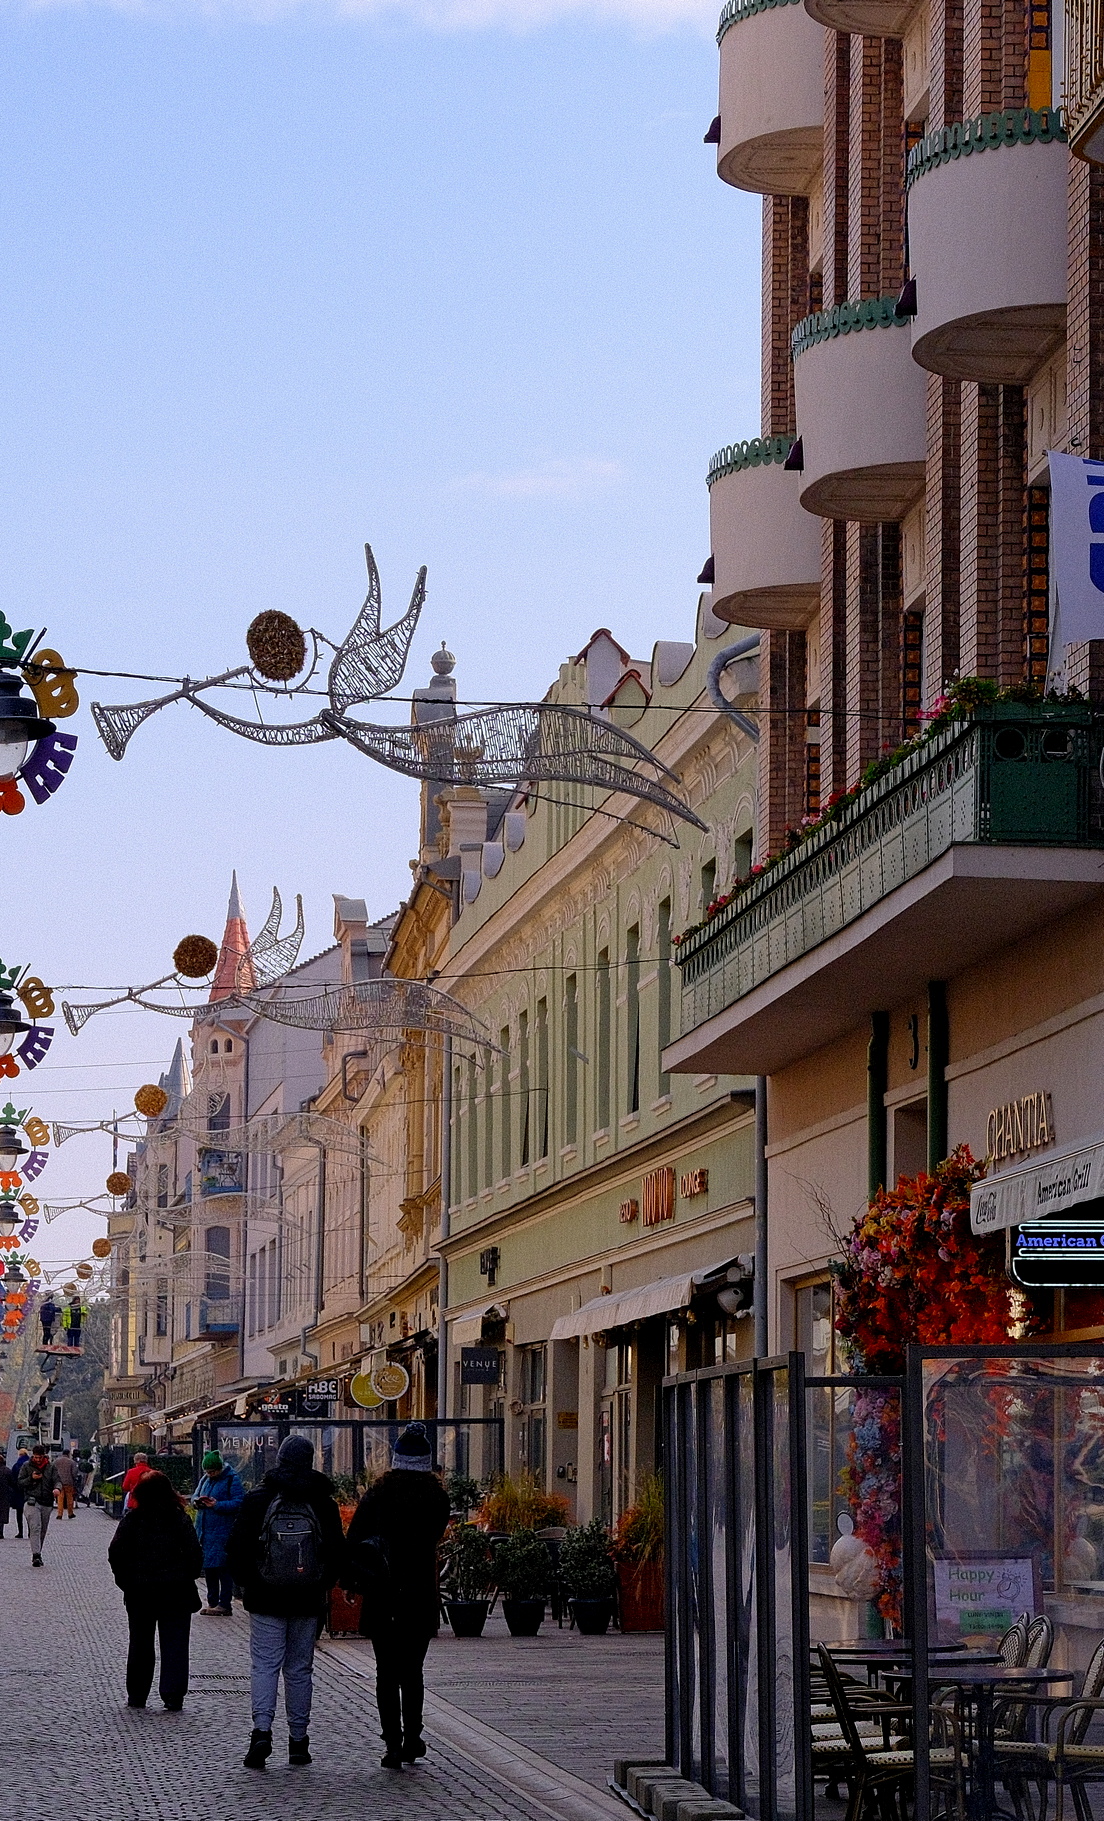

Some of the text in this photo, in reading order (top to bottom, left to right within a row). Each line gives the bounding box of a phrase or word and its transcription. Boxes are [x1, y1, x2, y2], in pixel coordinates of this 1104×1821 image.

[1038, 1162, 1092, 1205] American Grill
[1016, 1234, 1096, 1247] American
[463, 1360, 496, 1371] VENUE
[221, 1436, 274, 1452] VENUE
[949, 1568, 994, 1583] Happy
[950, 1589, 985, 1601] Hour
